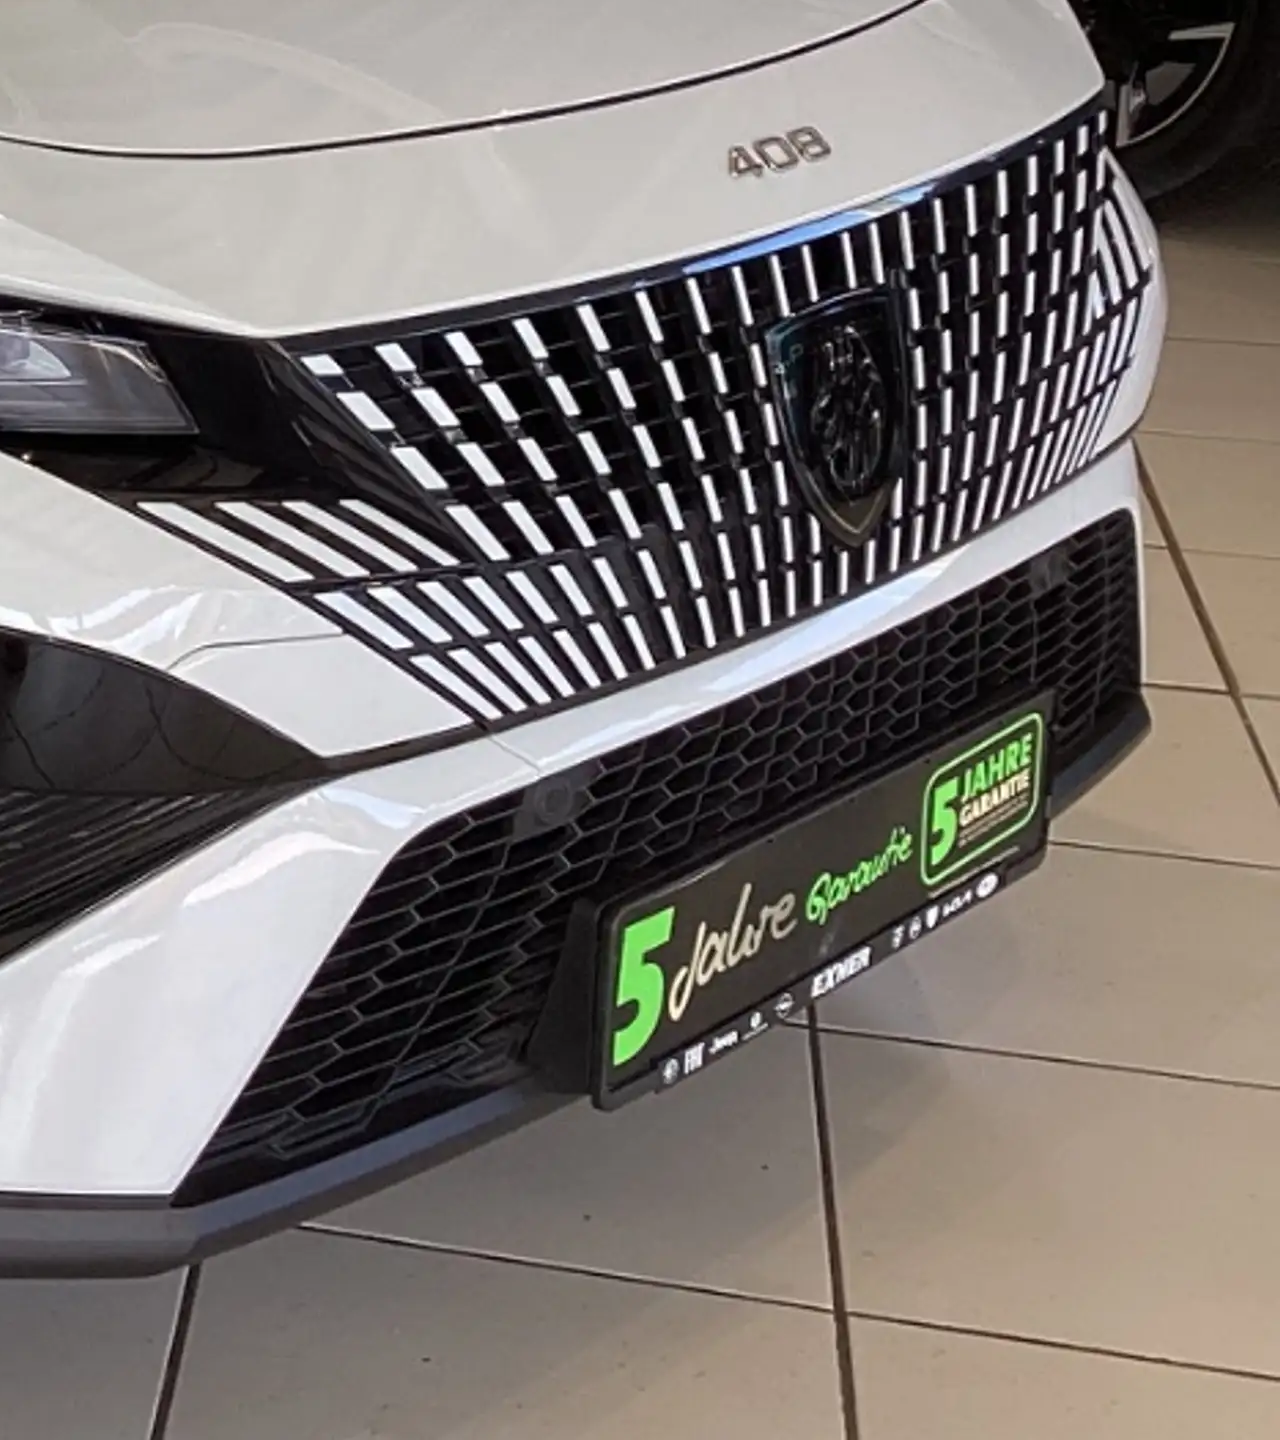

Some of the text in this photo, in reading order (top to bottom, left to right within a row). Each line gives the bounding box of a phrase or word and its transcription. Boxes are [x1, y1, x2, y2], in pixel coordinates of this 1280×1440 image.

[728, 126, 831, 179] 408
[959, 768, 1030, 827] GARANTIE
[960, 733, 1032, 803] JAHRE
[931, 775, 958, 867] 5
[613, 826, 913, 1067] 5 Jahre Garantie
